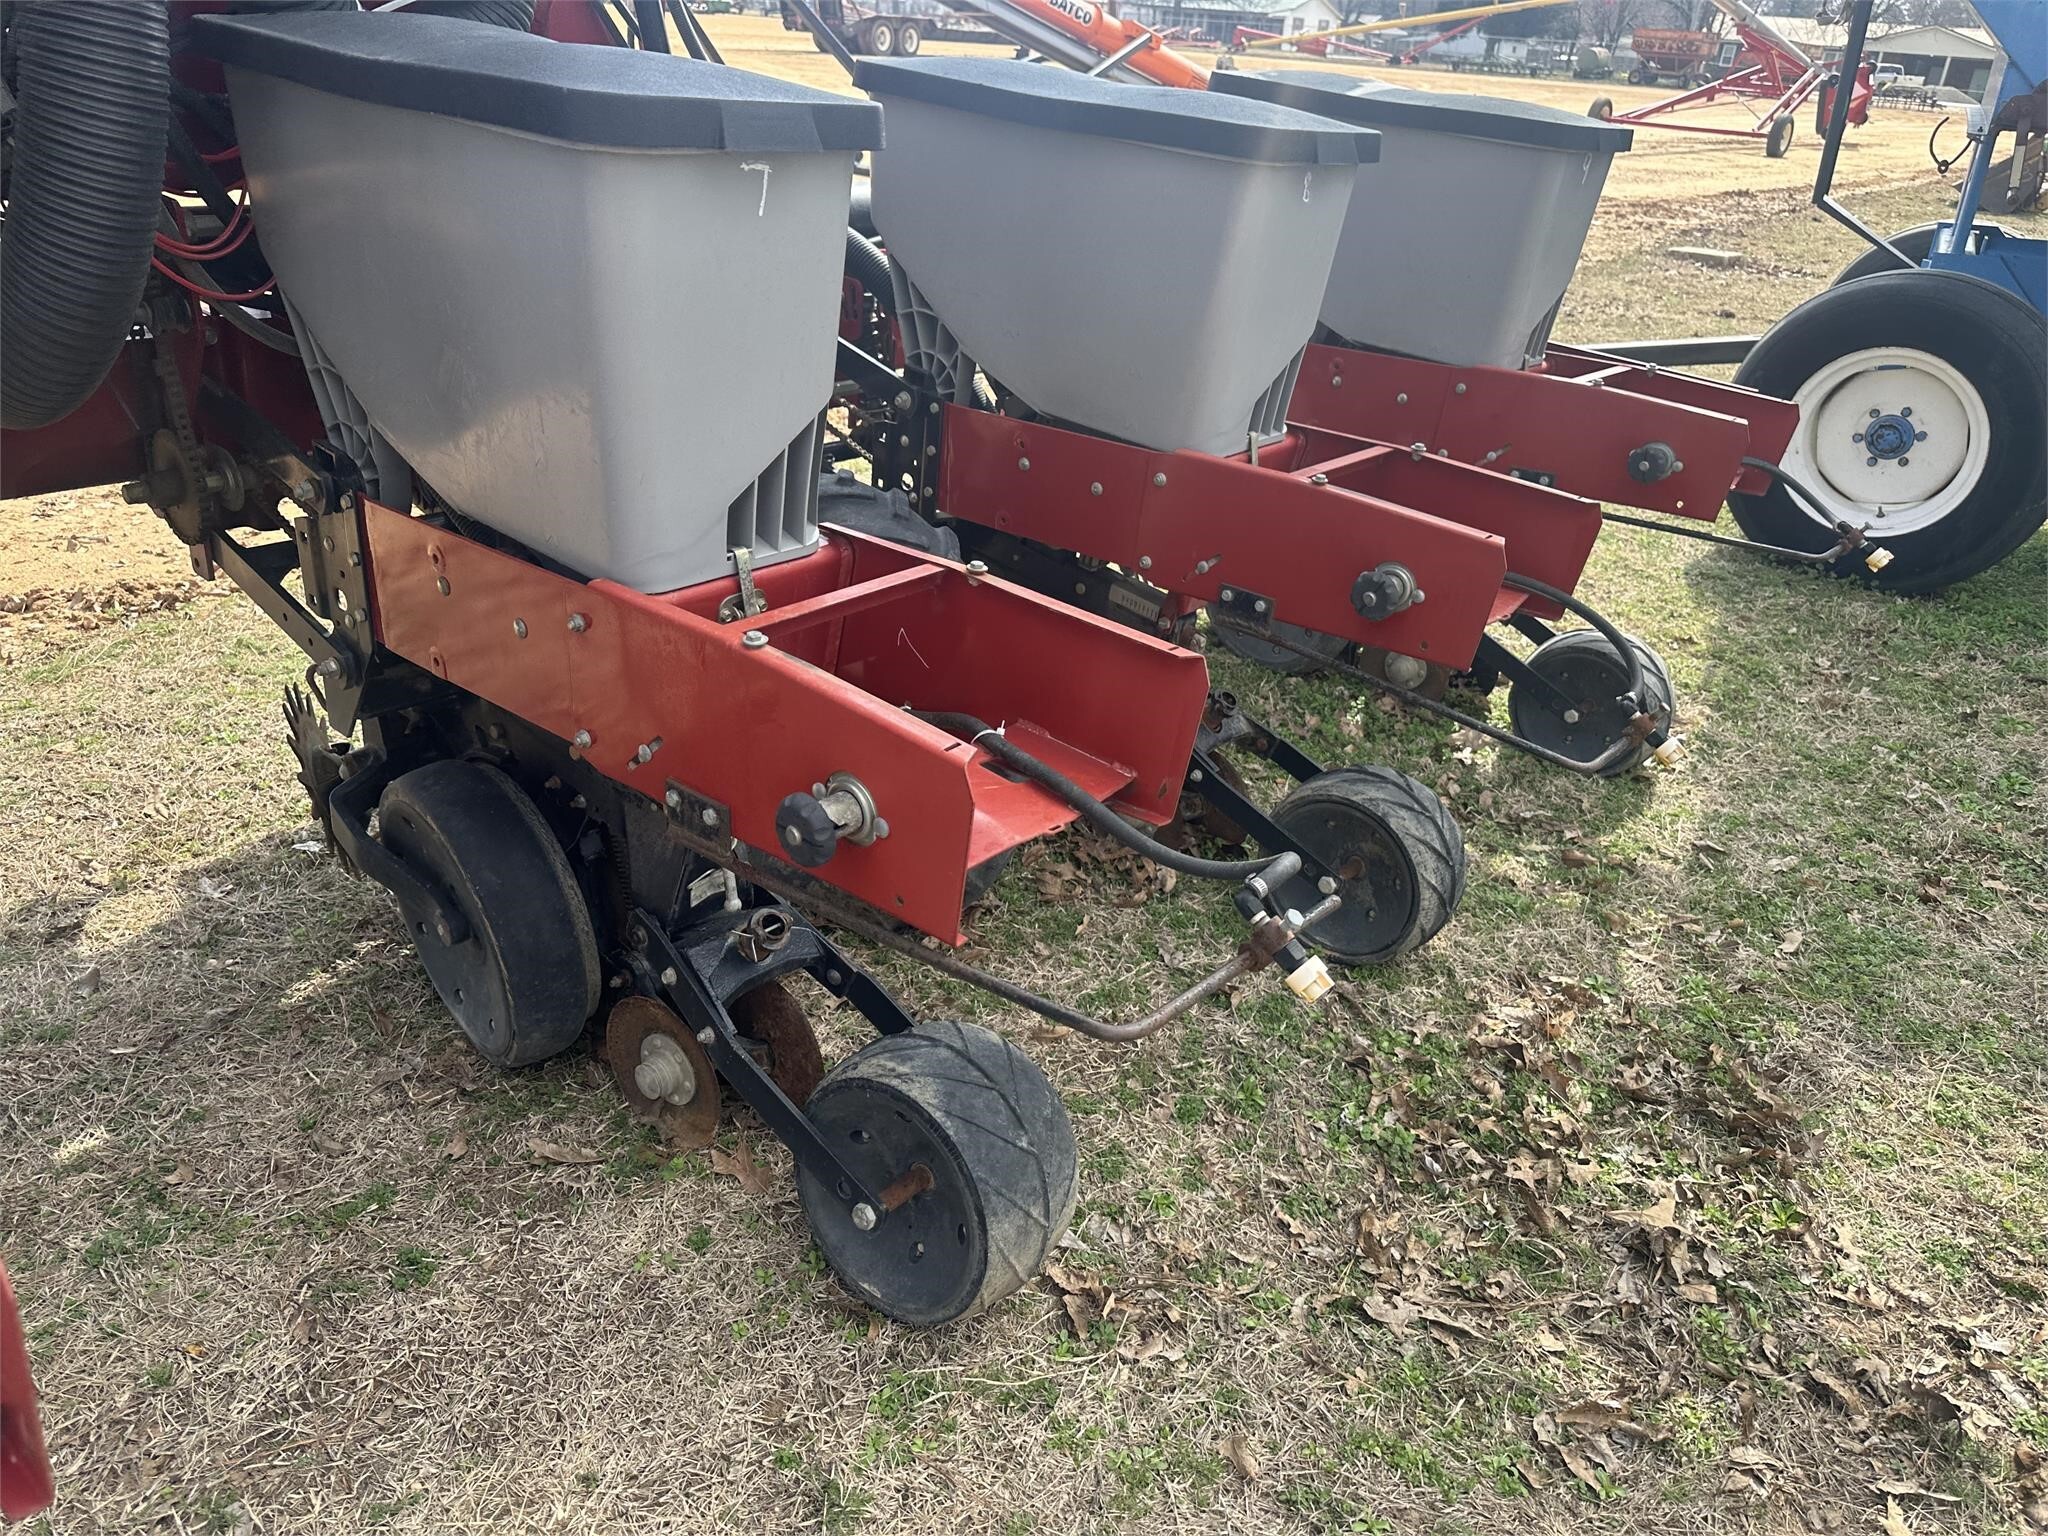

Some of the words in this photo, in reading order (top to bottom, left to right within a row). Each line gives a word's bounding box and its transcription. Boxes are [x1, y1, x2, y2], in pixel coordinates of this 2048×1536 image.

[1581, 151, 1593, 185] 9
[739, 162, 772, 217] 7
[1302, 171, 1312, 202] 8
